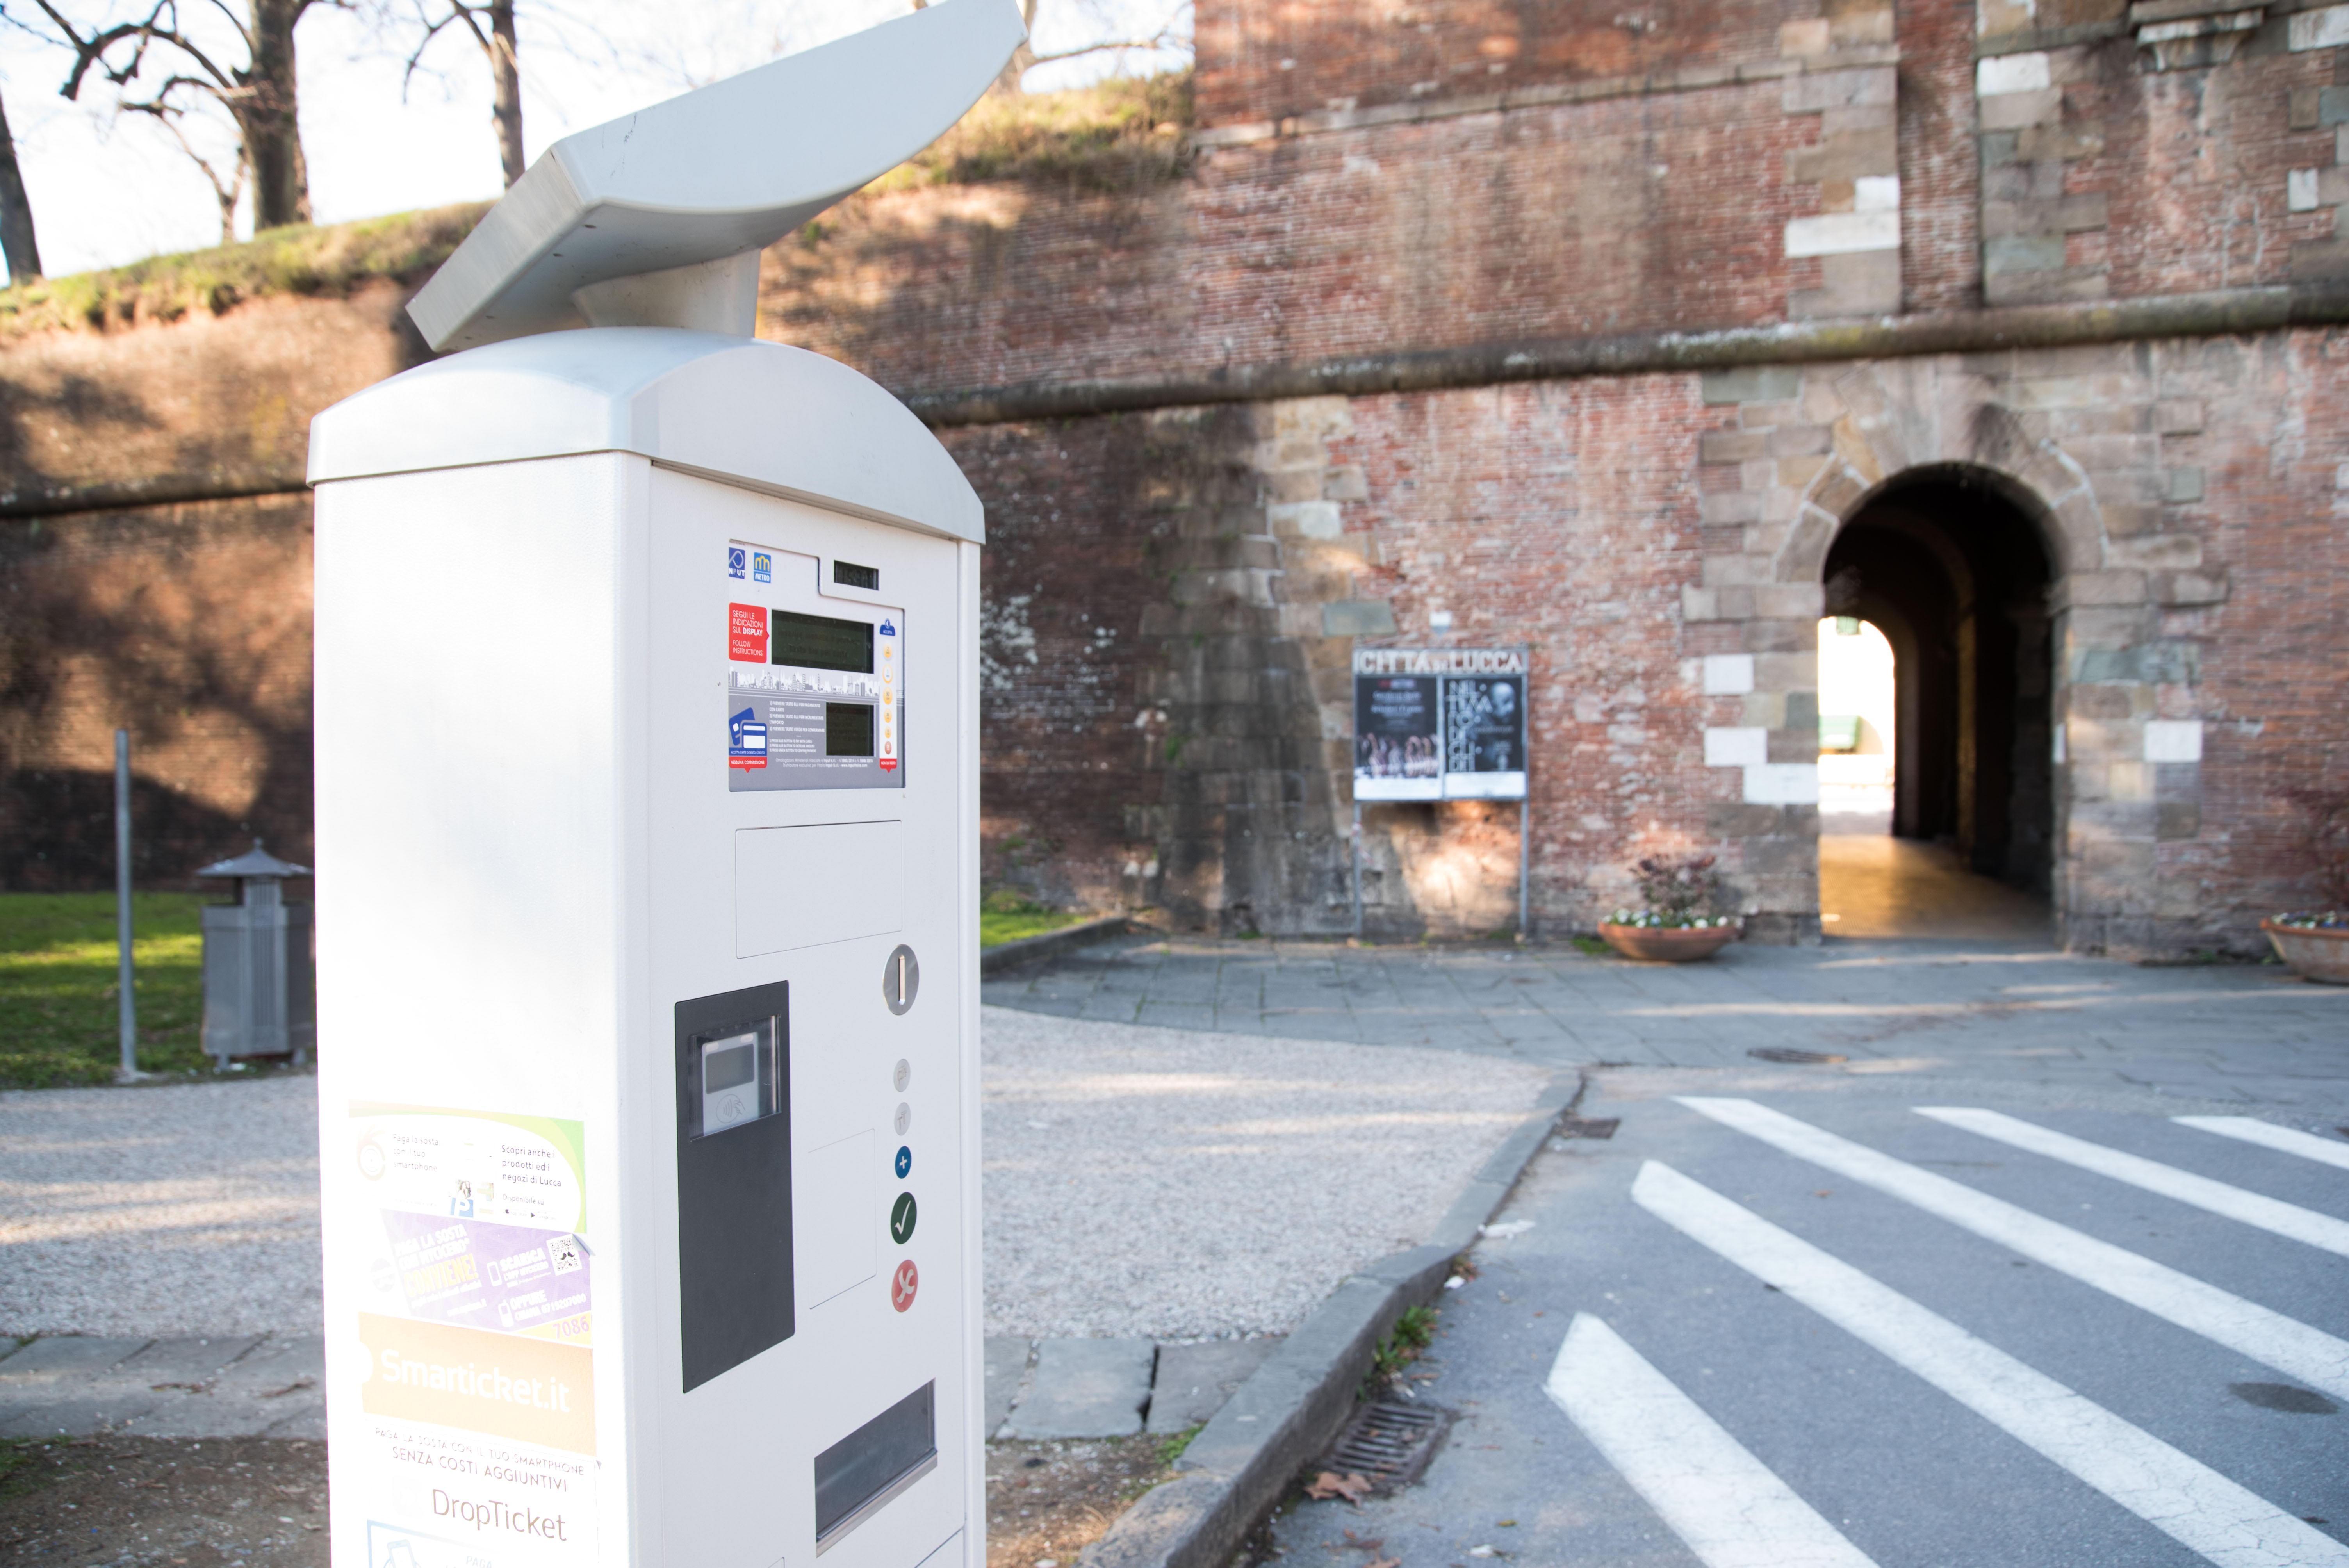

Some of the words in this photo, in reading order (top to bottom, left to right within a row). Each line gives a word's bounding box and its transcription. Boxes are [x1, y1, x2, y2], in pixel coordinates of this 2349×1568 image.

[755, 573, 770, 581] METRO
[733, 609, 748, 618] SEGUI
[733, 618, 763, 628] INDICAZIONI
[743, 627, 763, 636] DISPLAY
[733, 648, 763, 656] INSTRUCTIONS
[1449, 650, 1523, 675] LUCCA
[393, 1133, 410, 1144] Paga
[412, 1135, 418, 1143] la
[501, 1144, 525, 1156] Scopri
[528, 1149, 551, 1158] anche
[553, 1150, 555, 1158] i
[394, 1161, 437, 1172] smartphone
[502, 1160, 534, 1169] prodotti
[547, 1163, 550, 1172] i
[503, 1174, 528, 1183] negozi
[530, 1175, 537, 1183] di
[540, 1176, 561, 1187] Lucca
[503, 1194, 536, 1204] Disponibile
[420, 1233, 436, 1249] LA
[435, 1223, 467, 1244] SOSTA
[499, 1247, 546, 1272] SCARICA
[404, 1253, 479, 1298] CONVIENE!
[510, 1289, 547, 1310] OPPURE
[514, 1306, 542, 1321] CHIAMA
[541, 1292, 586, 1314] 0719207000
[552, 1315, 590, 1339] 7086
[380, 1348, 570, 1413] Smarticket.it
[375, 1427, 398, 1440] PAGA
[403, 1433, 413, 1443] LA
[418, 1435, 447, 1449] SOSTA
[451, 1441, 472, 1454] CON
[477, 1447, 485, 1457] IL
[490, 1449, 510, 1461] TUO
[514, 1454, 585, 1476] SMARTPHONE
[392, 1446, 434, 1466] SENZA
[439, 1456, 478, 1475] COSTI
[484, 1465, 567, 1493] AGGIUNTIVI
[432, 1488, 567, 1542] DropTicket
[466, 1555, 492, 1568] PAGA
